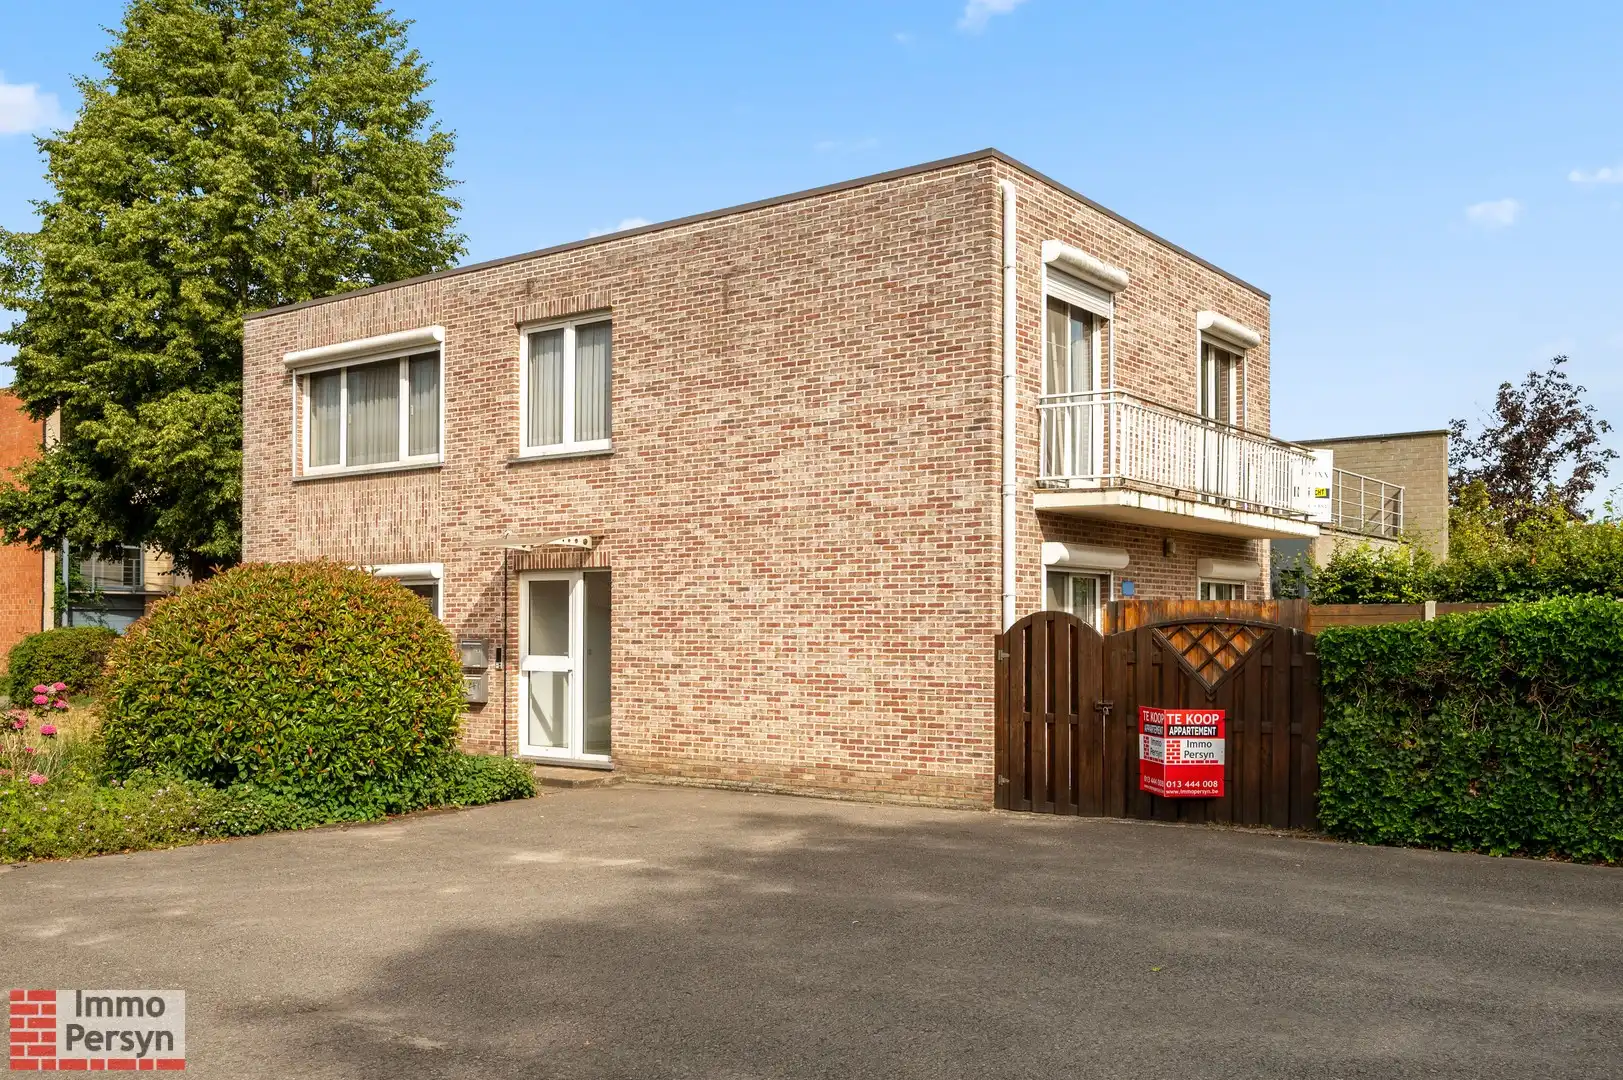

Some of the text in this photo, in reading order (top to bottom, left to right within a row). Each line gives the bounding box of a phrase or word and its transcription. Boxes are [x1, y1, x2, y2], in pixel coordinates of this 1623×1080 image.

[1143, 711, 1164, 724] TE KOOP
[1166, 714, 1219, 724] TE KOOP
[1169, 726, 1217, 736] APPARTEMENT
[1186, 740, 1212, 748] Immo
[1184, 750, 1214, 760] Persyn
[1166, 780, 1218, 788] 013 444 008
